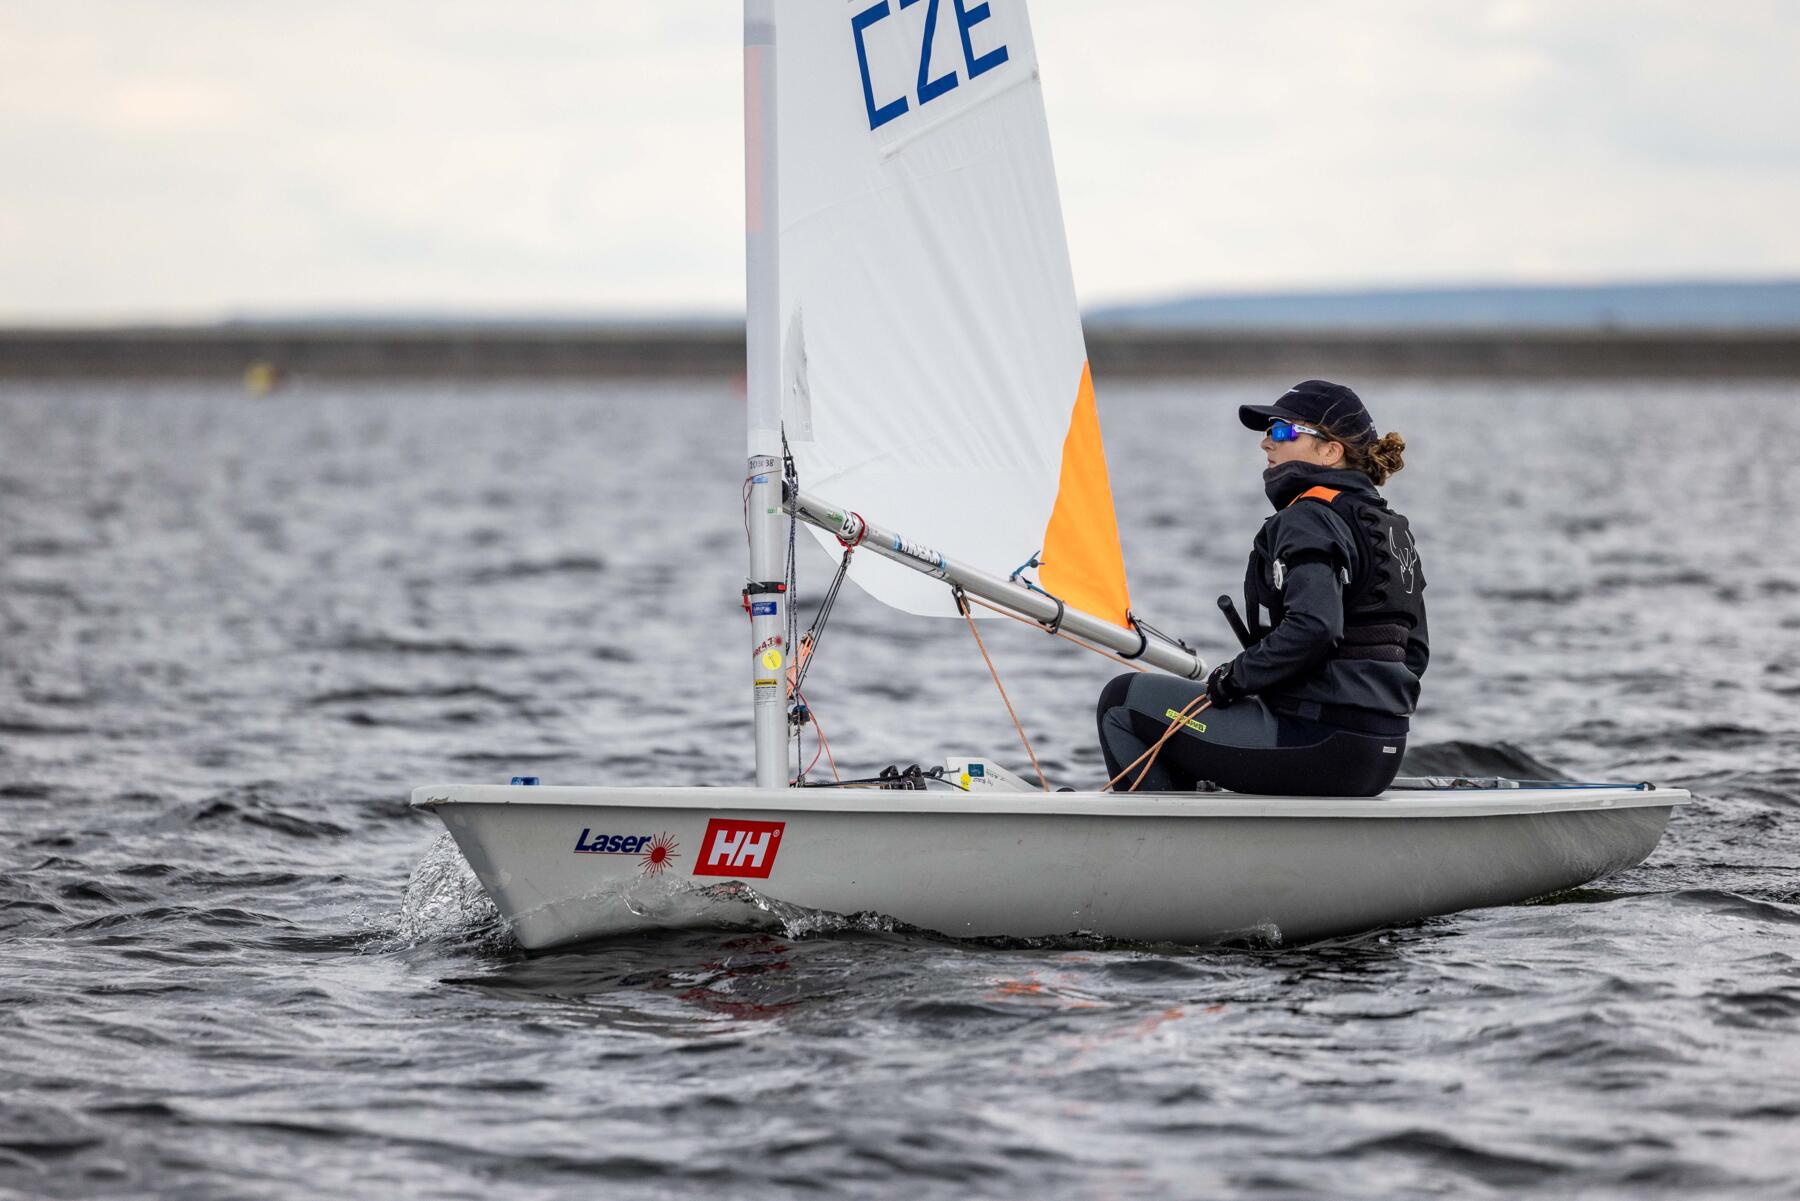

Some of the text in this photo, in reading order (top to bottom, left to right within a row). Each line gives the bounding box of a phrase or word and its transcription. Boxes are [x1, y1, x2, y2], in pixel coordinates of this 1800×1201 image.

[851, 0, 1009, 131] CZE
[574, 828, 652, 853] Laser
[707, 829, 772, 868] HH
